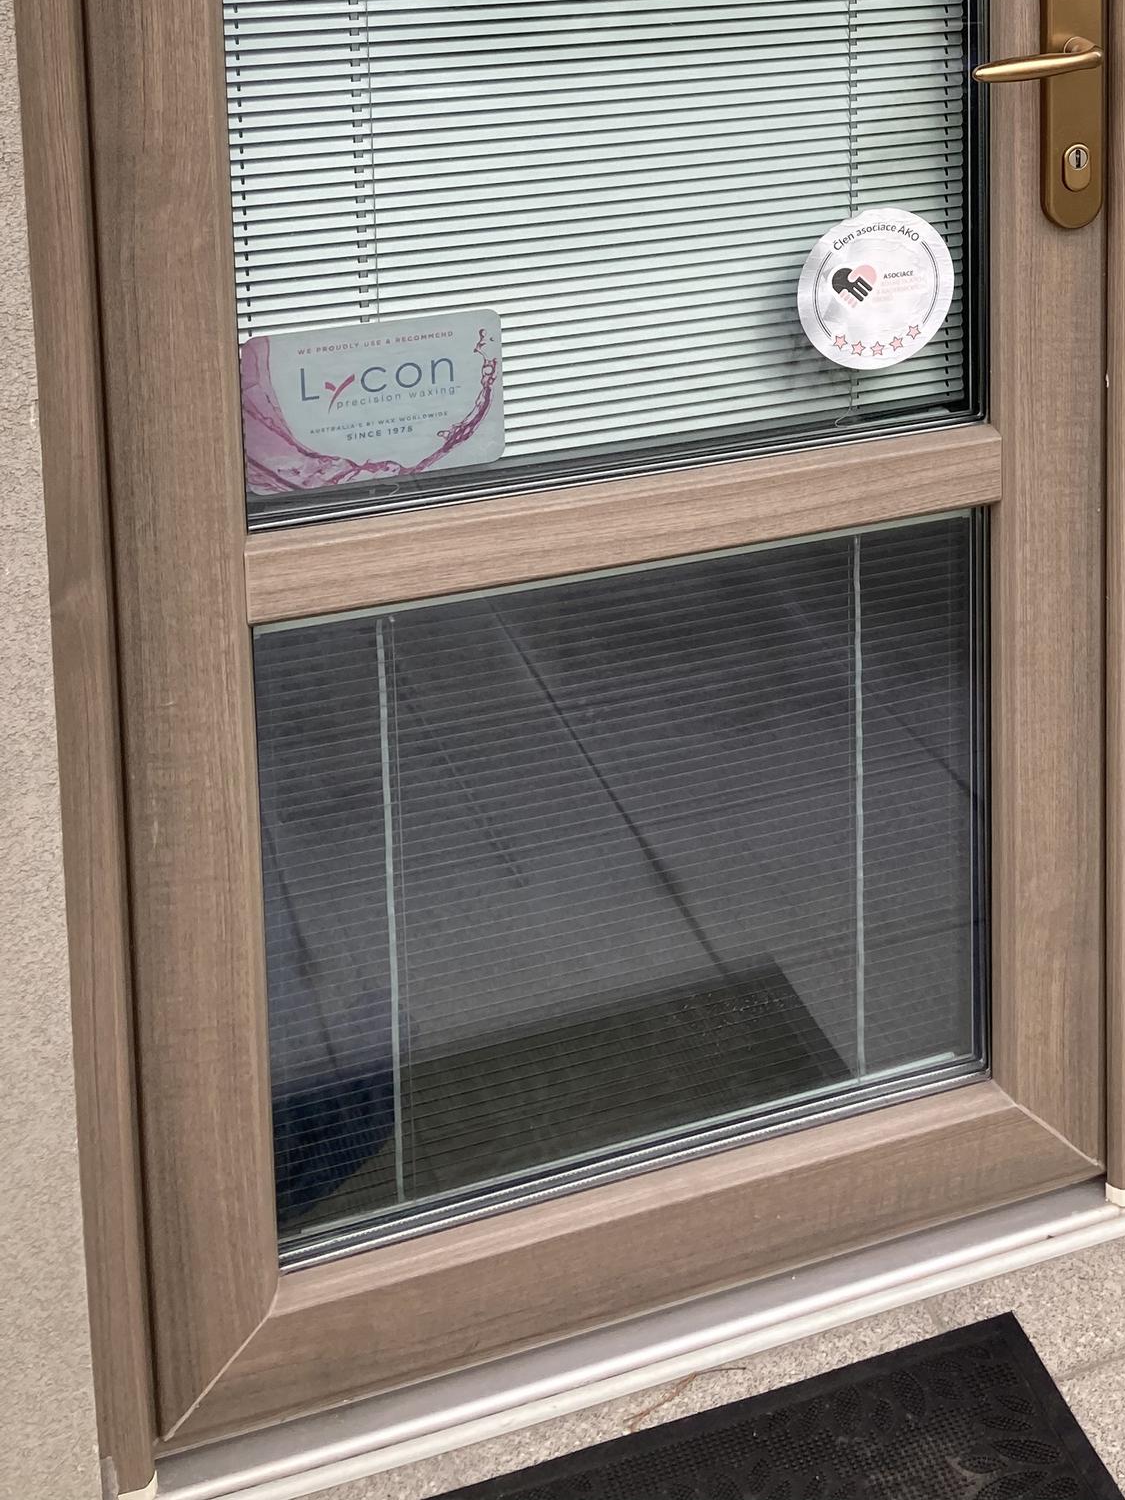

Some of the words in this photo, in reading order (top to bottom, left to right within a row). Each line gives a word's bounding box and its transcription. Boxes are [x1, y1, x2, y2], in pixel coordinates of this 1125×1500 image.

[832, 233, 855, 251] Člen
[856, 224, 897, 237] asociace
[897, 225, 920, 242] AKO
[883, 270, 914, 279] ASOCIACE
[297, 348, 312, 356] WE
[316, 342, 360, 353] PROUDLY
[364, 339, 381, 348] USE
[395, 331, 454, 343] RECOMMEND
[336, 392, 402, 410] precision
[346, 429, 382, 442] SINCE
